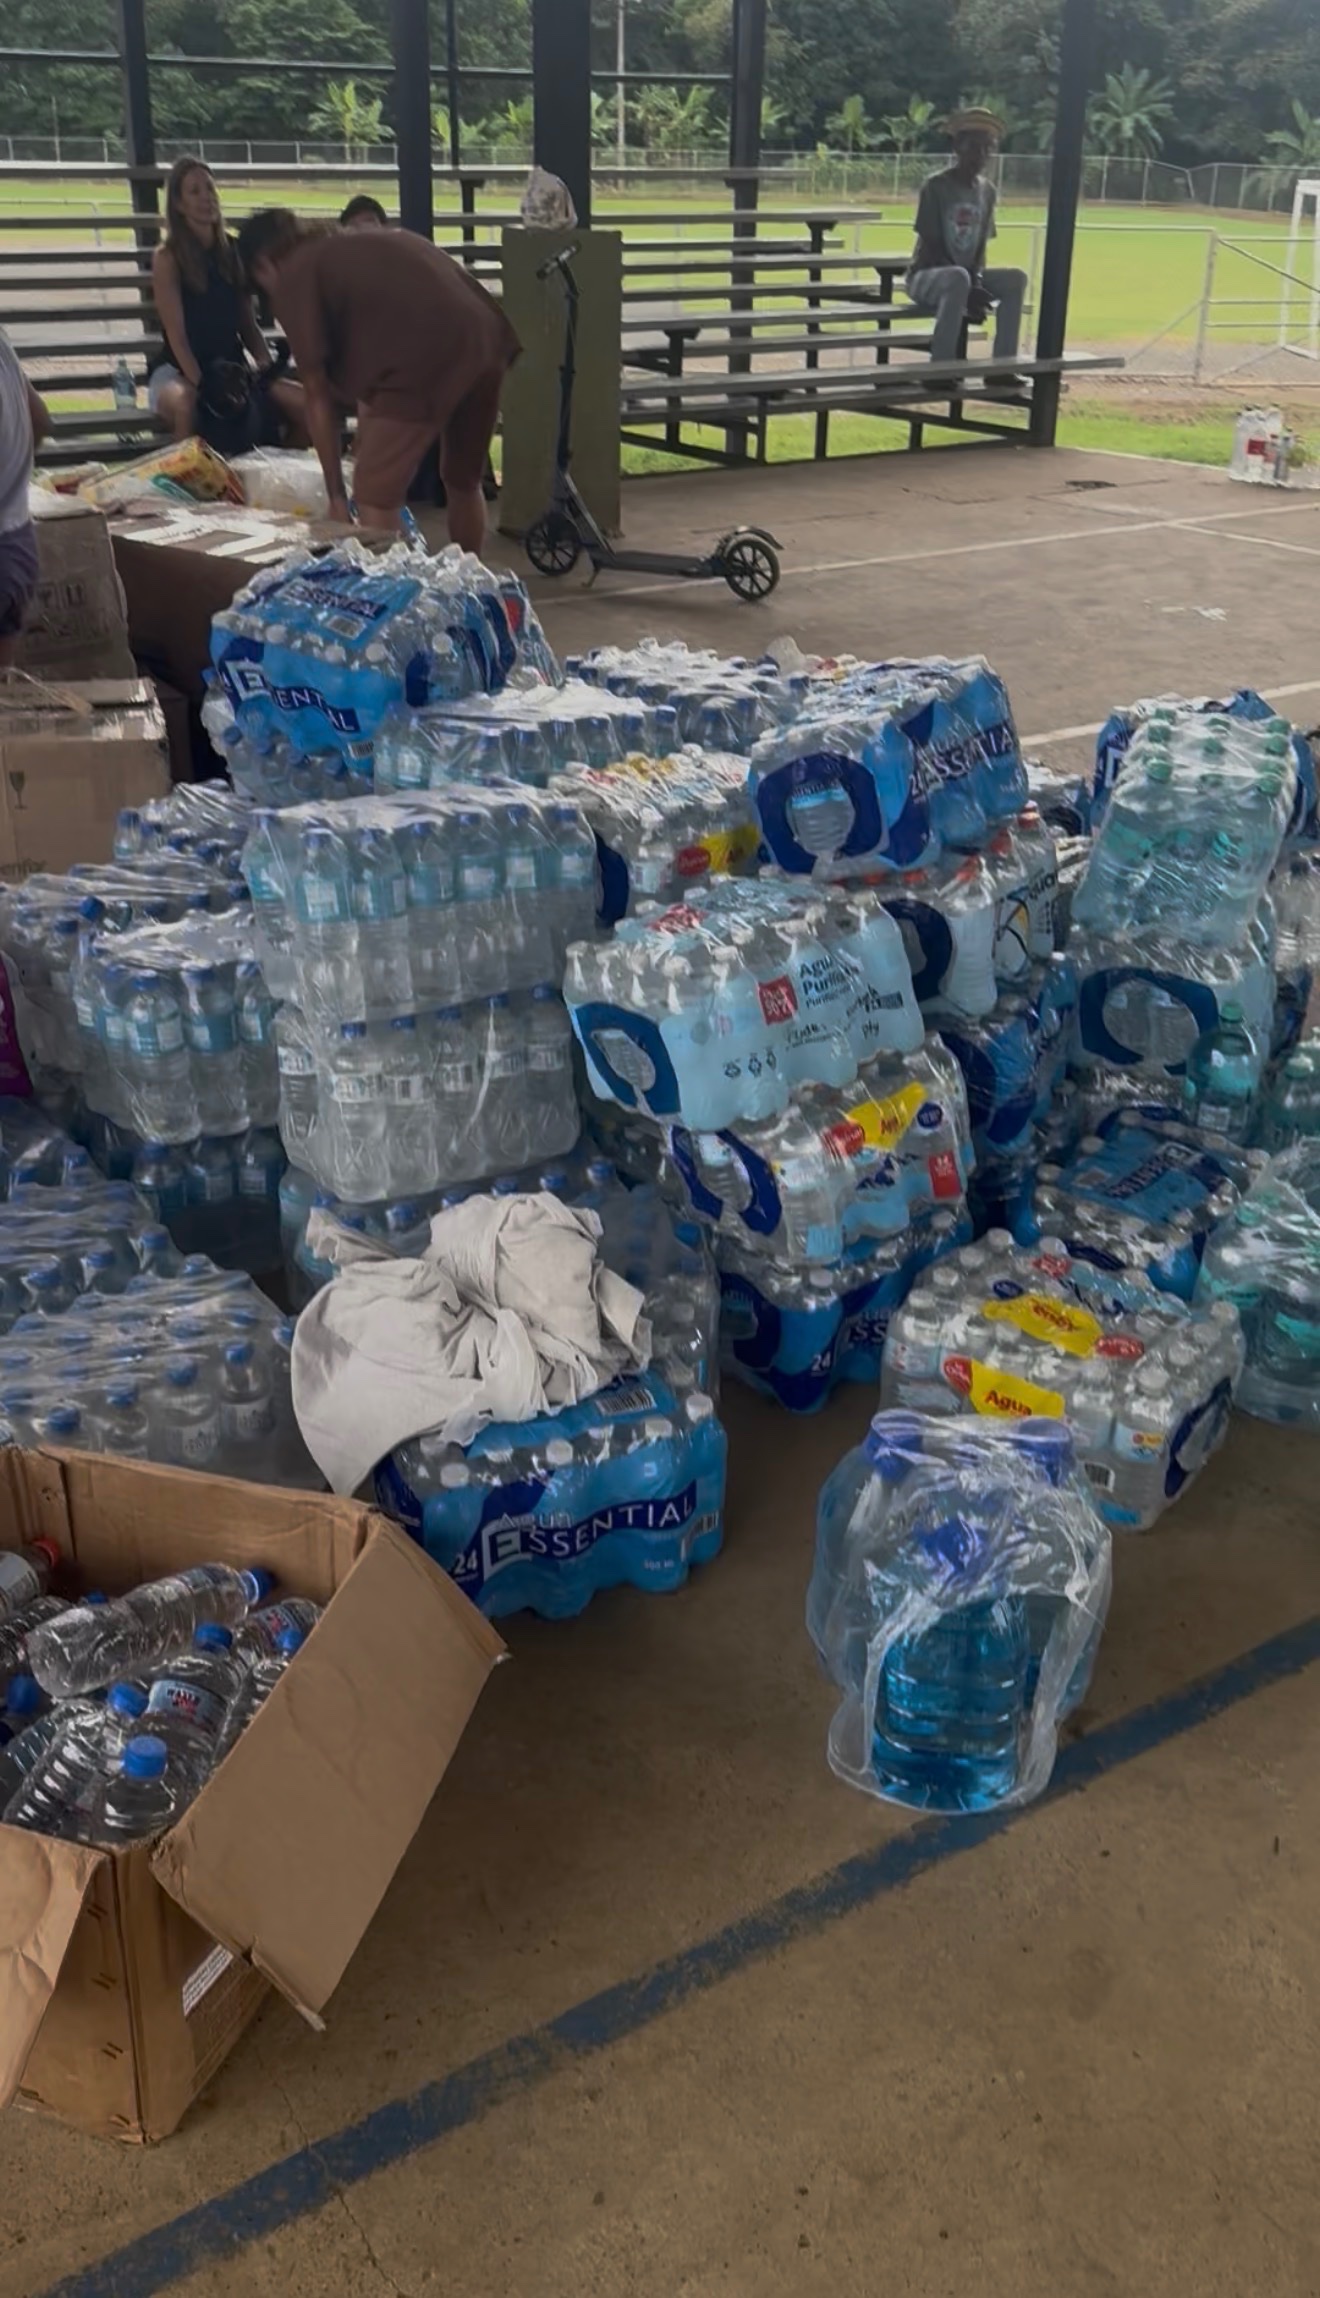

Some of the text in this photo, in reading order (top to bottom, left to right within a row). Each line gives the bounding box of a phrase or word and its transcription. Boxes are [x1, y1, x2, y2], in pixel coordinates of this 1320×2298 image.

[811, 1353, 832, 1373] 24
[984, 1390, 1033, 1417] Agua
[482, 1494, 694, 1582] ESSENTIAL
[453, 1551, 478, 1576] 24
